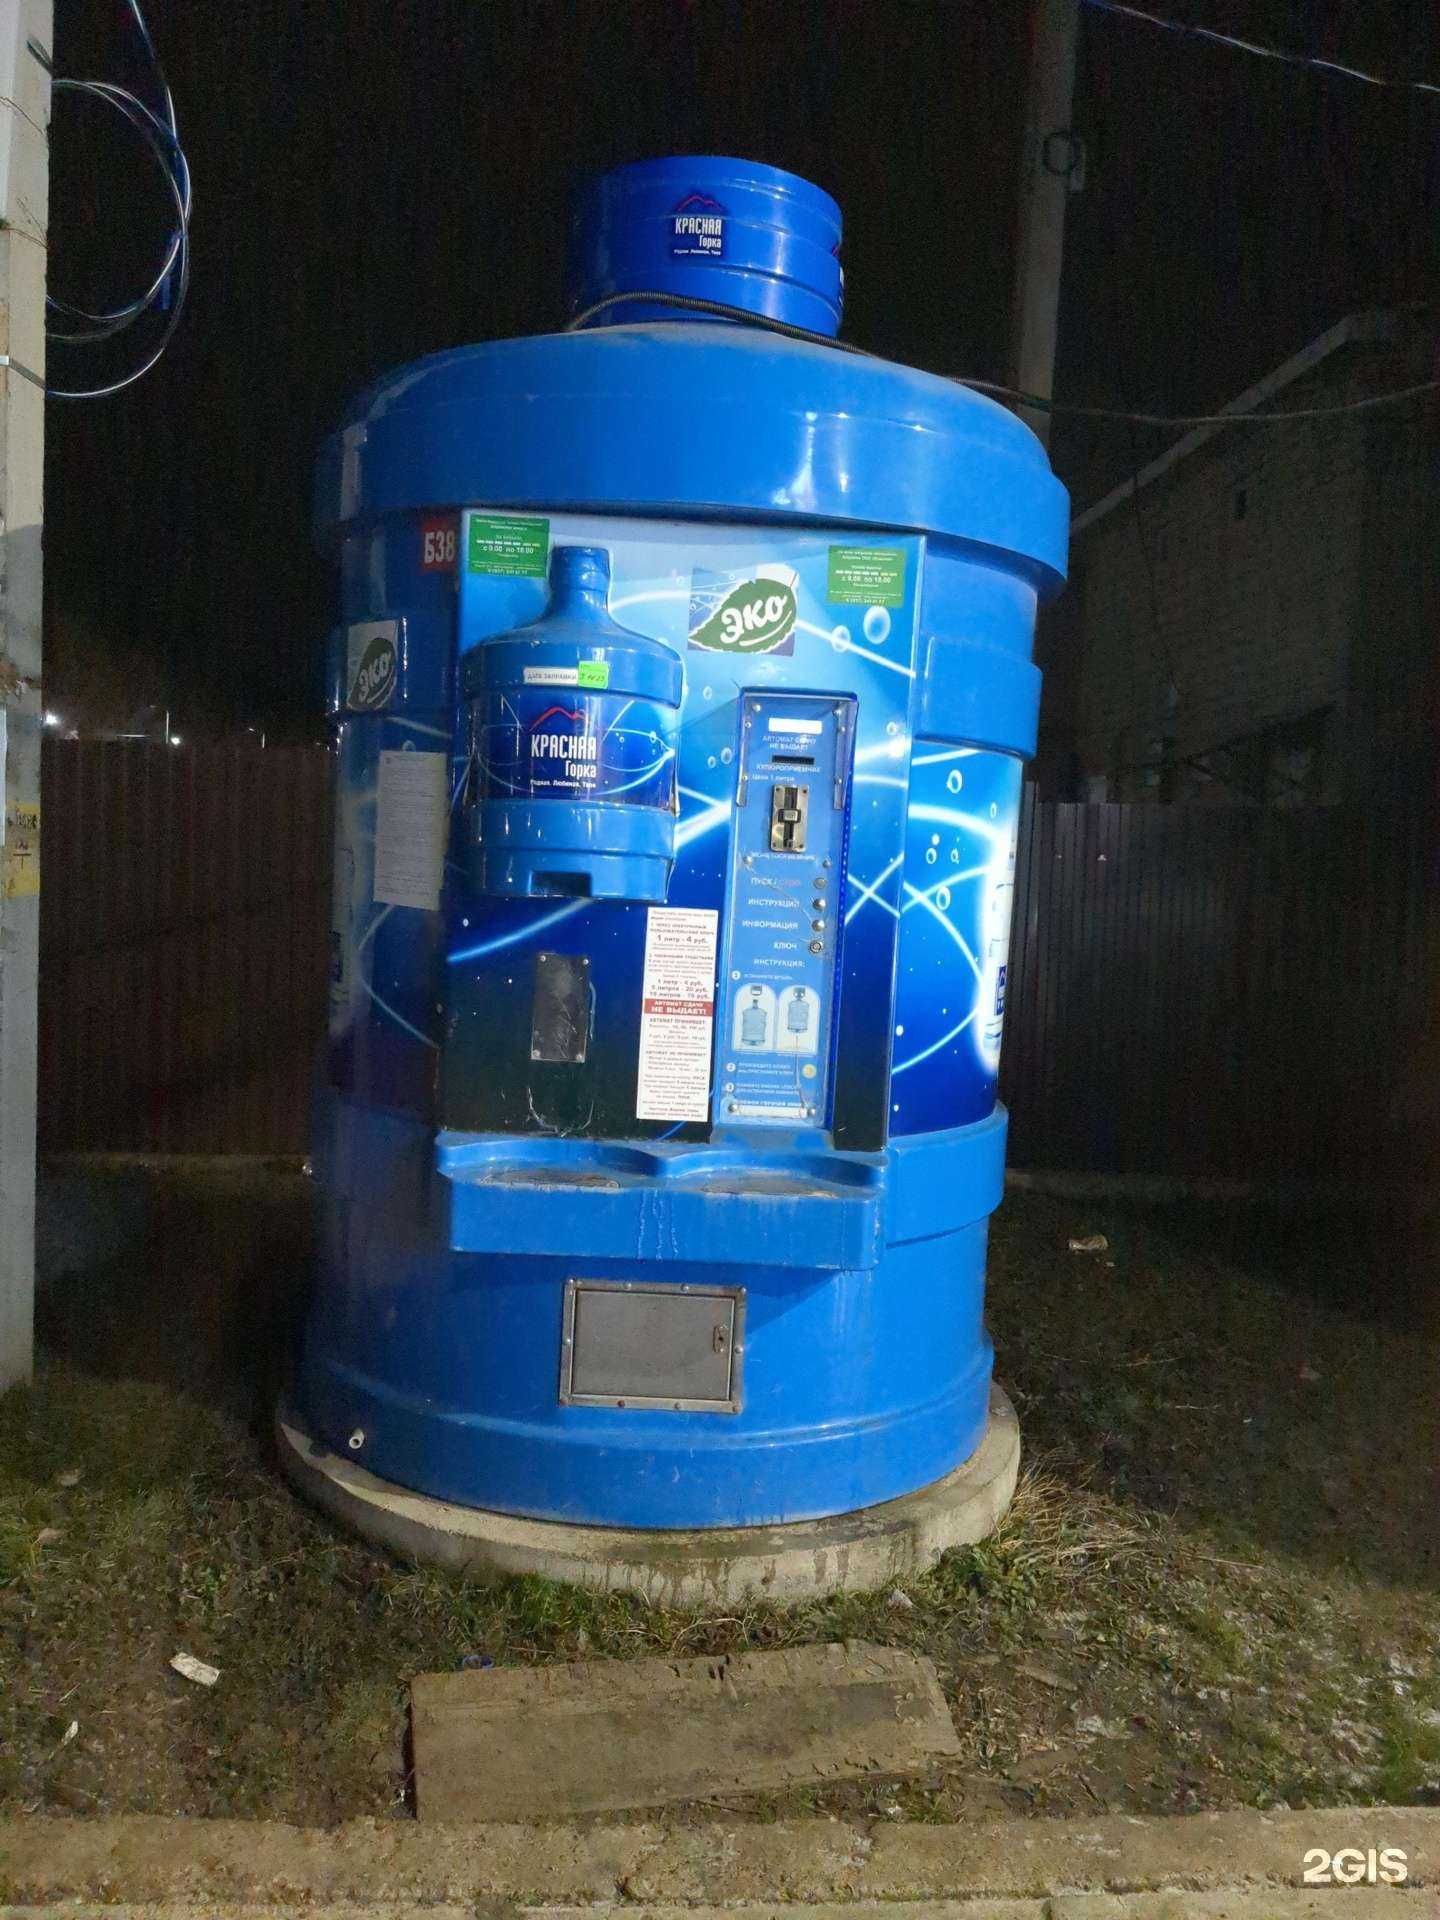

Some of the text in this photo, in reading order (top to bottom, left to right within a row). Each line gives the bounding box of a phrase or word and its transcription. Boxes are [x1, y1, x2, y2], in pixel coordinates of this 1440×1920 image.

[675, 218, 722, 236] КРАСНАЯ
[699, 235, 722, 249] Горка
[424, 530, 456, 563] Б38
[531, 734, 597, 760] КРАСНАЯ
[565, 760, 597, 780] Горка
[752, 877, 773, 886] ПУСК
[742, 920, 798, 930] ИНФОРМАЦИЯ
[773, 942, 797, 950] КЛЮЧ
